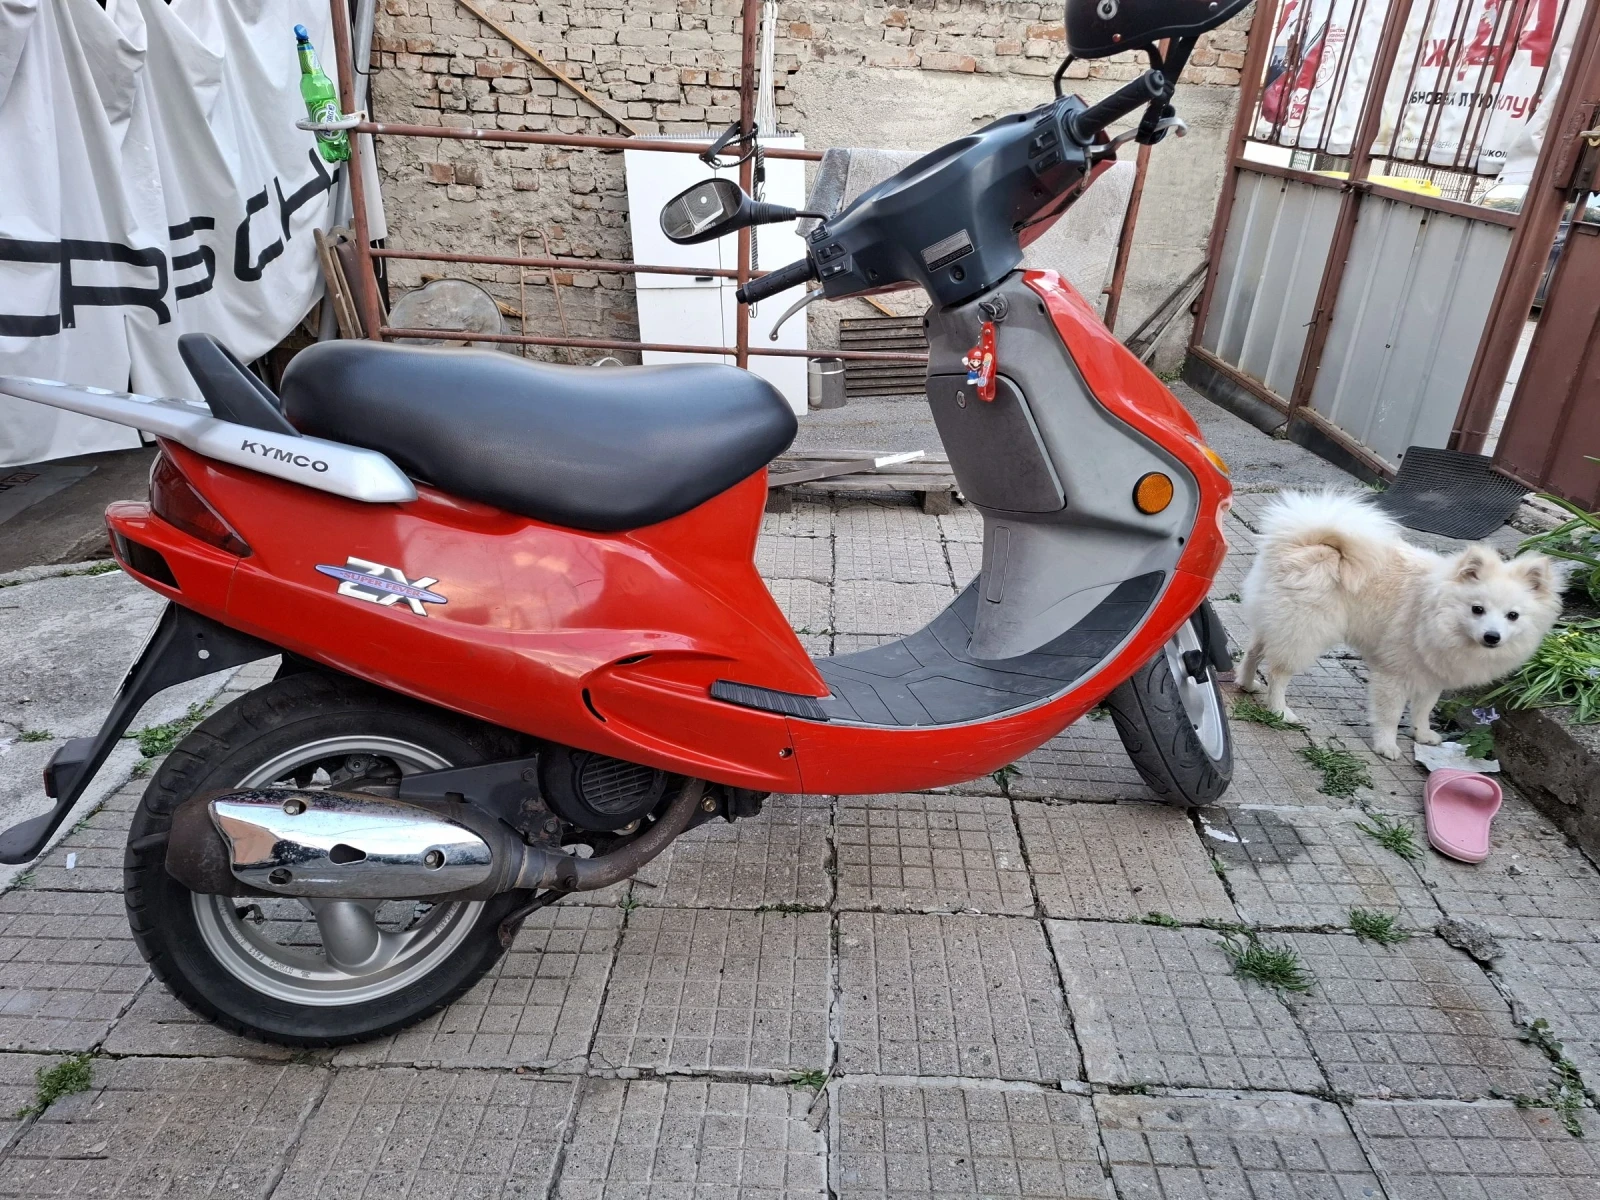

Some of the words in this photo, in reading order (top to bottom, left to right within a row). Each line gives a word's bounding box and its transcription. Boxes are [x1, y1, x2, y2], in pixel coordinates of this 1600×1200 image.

[0, 147, 340, 337] RSCH
[241, 440, 329, 473] KYMCO
[337, 556, 439, 617] ZX
